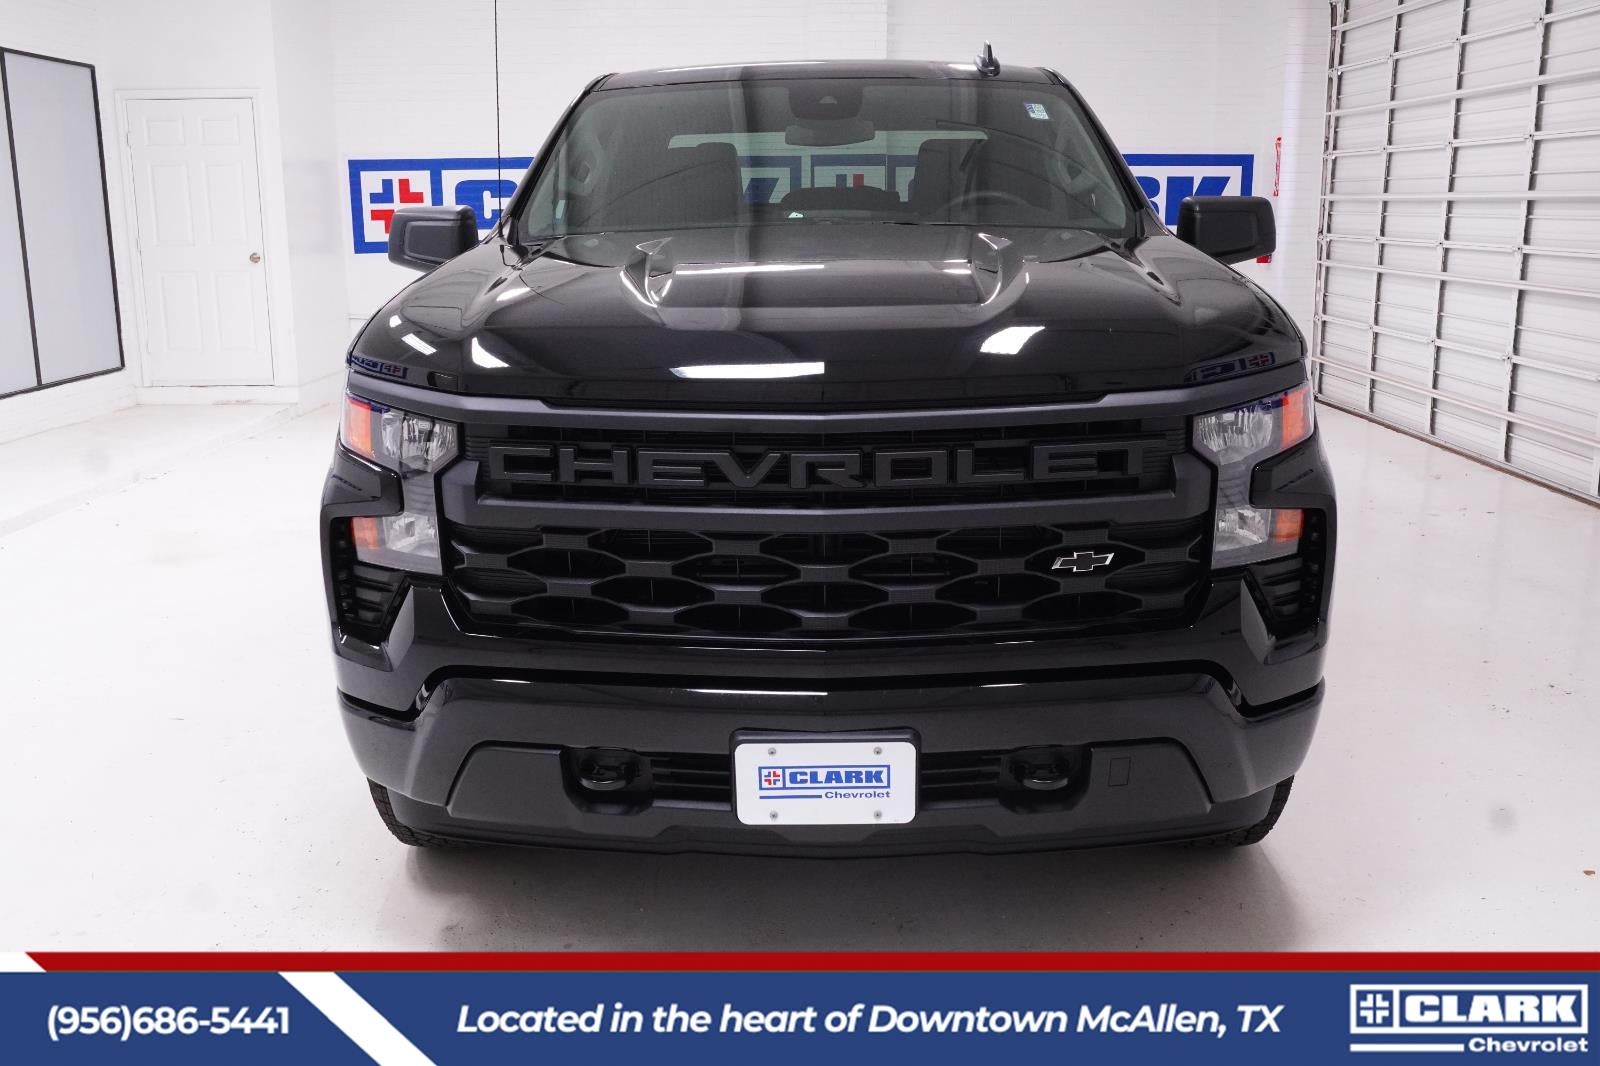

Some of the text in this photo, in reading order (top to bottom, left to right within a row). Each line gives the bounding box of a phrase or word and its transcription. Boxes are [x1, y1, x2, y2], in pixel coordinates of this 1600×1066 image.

[489, 437, 1165, 490] CHEVROLET
[788, 770, 884, 785] CLARK
[824, 790, 891, 799] Chevrolet
